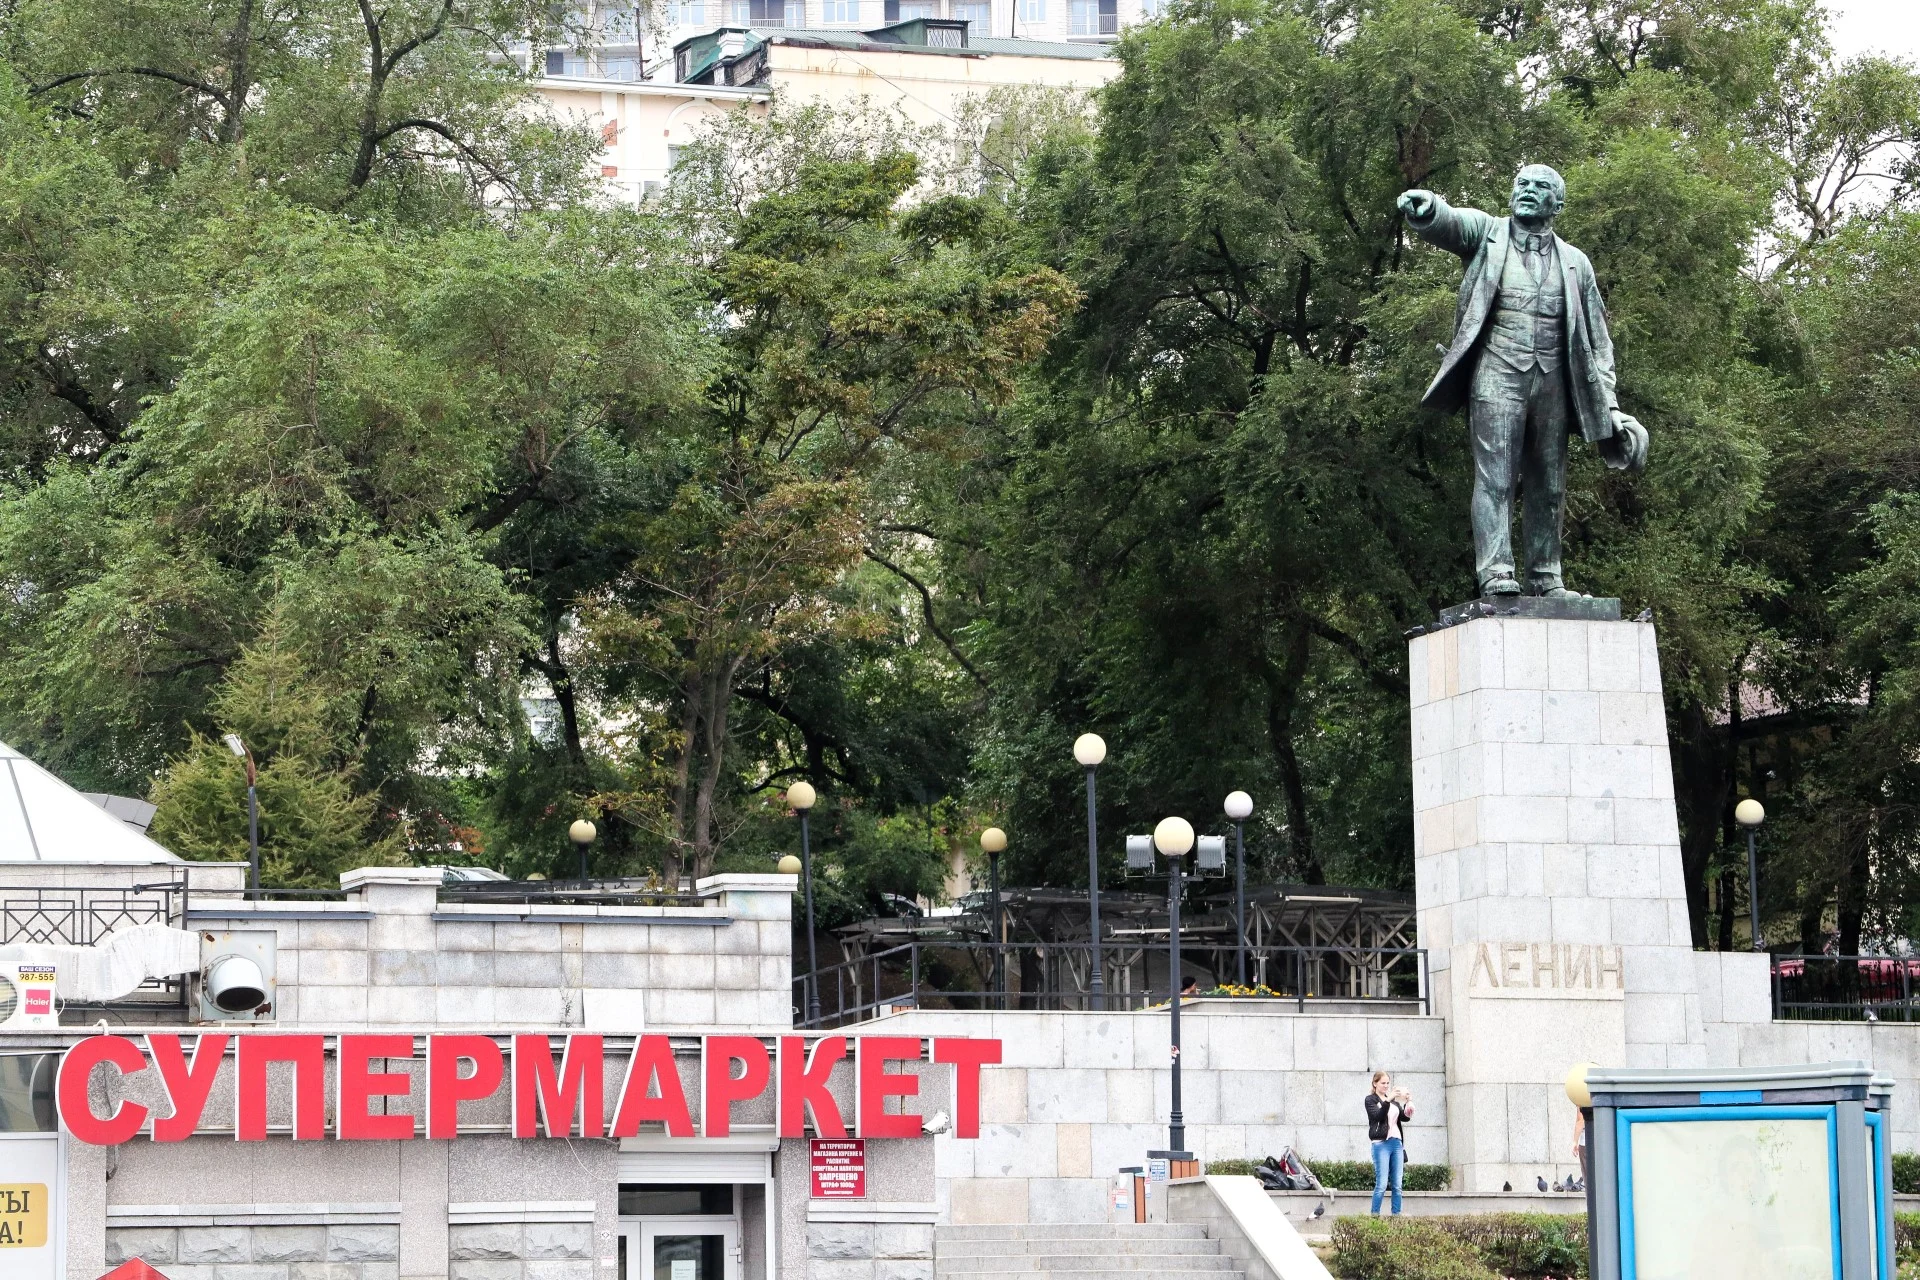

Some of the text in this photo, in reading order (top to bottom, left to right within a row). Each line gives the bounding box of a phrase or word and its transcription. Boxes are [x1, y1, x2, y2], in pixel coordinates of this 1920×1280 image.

[1469, 942, 1624, 989] ЛЕНИН
[56, 1033, 1003, 1145] СУПЕРМАРКЕТ
[818, 1173, 858, 1181] ЗАПРЕЩЕНО
